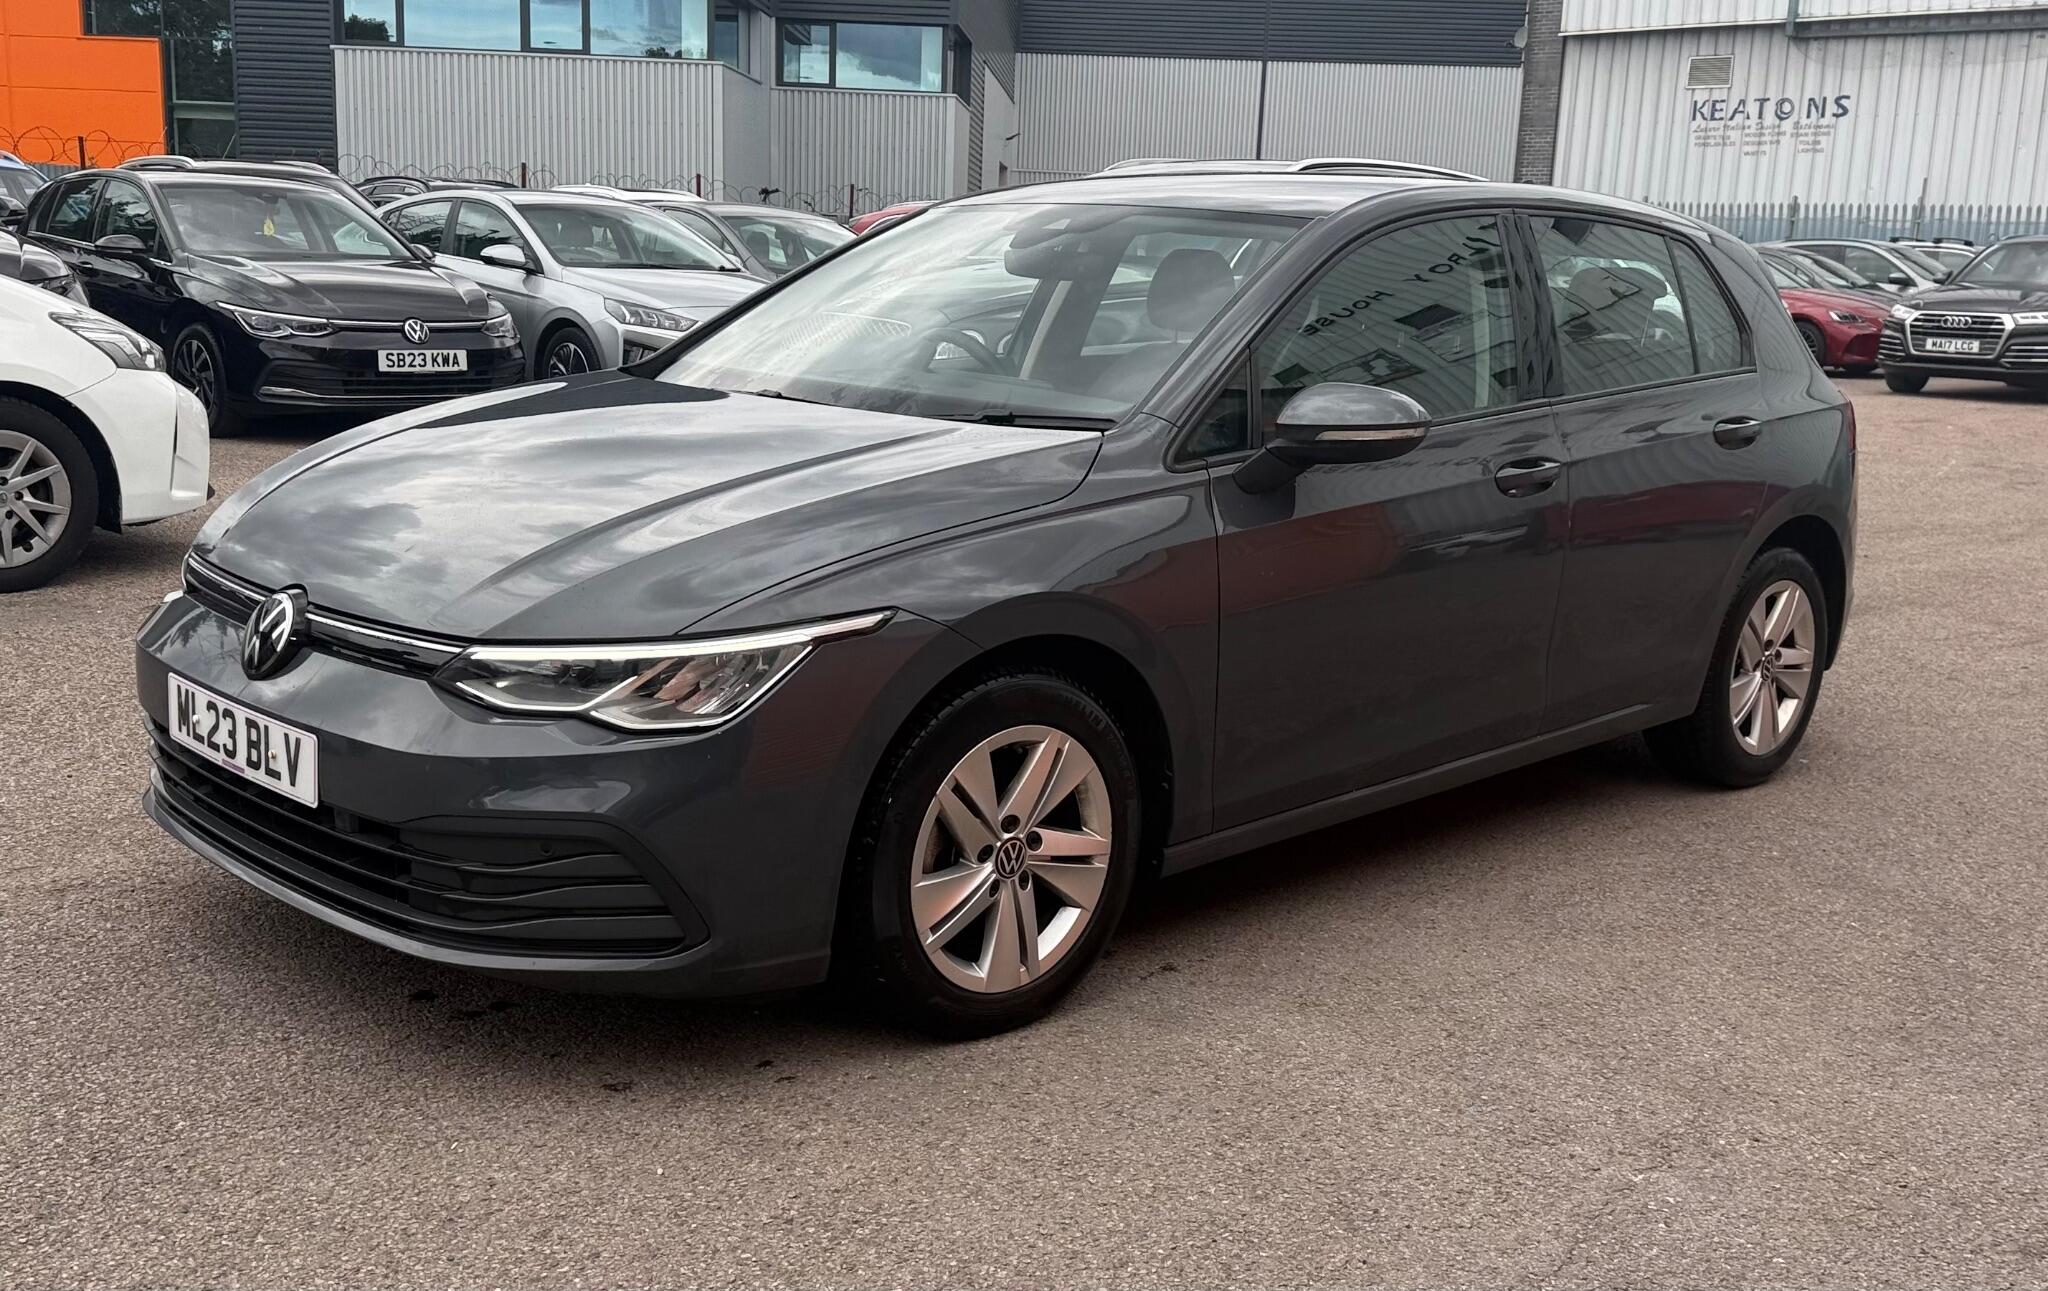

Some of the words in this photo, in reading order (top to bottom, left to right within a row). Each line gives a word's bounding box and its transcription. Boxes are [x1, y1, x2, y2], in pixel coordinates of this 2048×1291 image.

[1691, 95, 1851, 121] KEATONS
[385, 352, 427, 368] SB23
[431, 352, 460, 368] KWA
[177, 684, 238, 760] ML23
[245, 717, 302, 788] BLV
